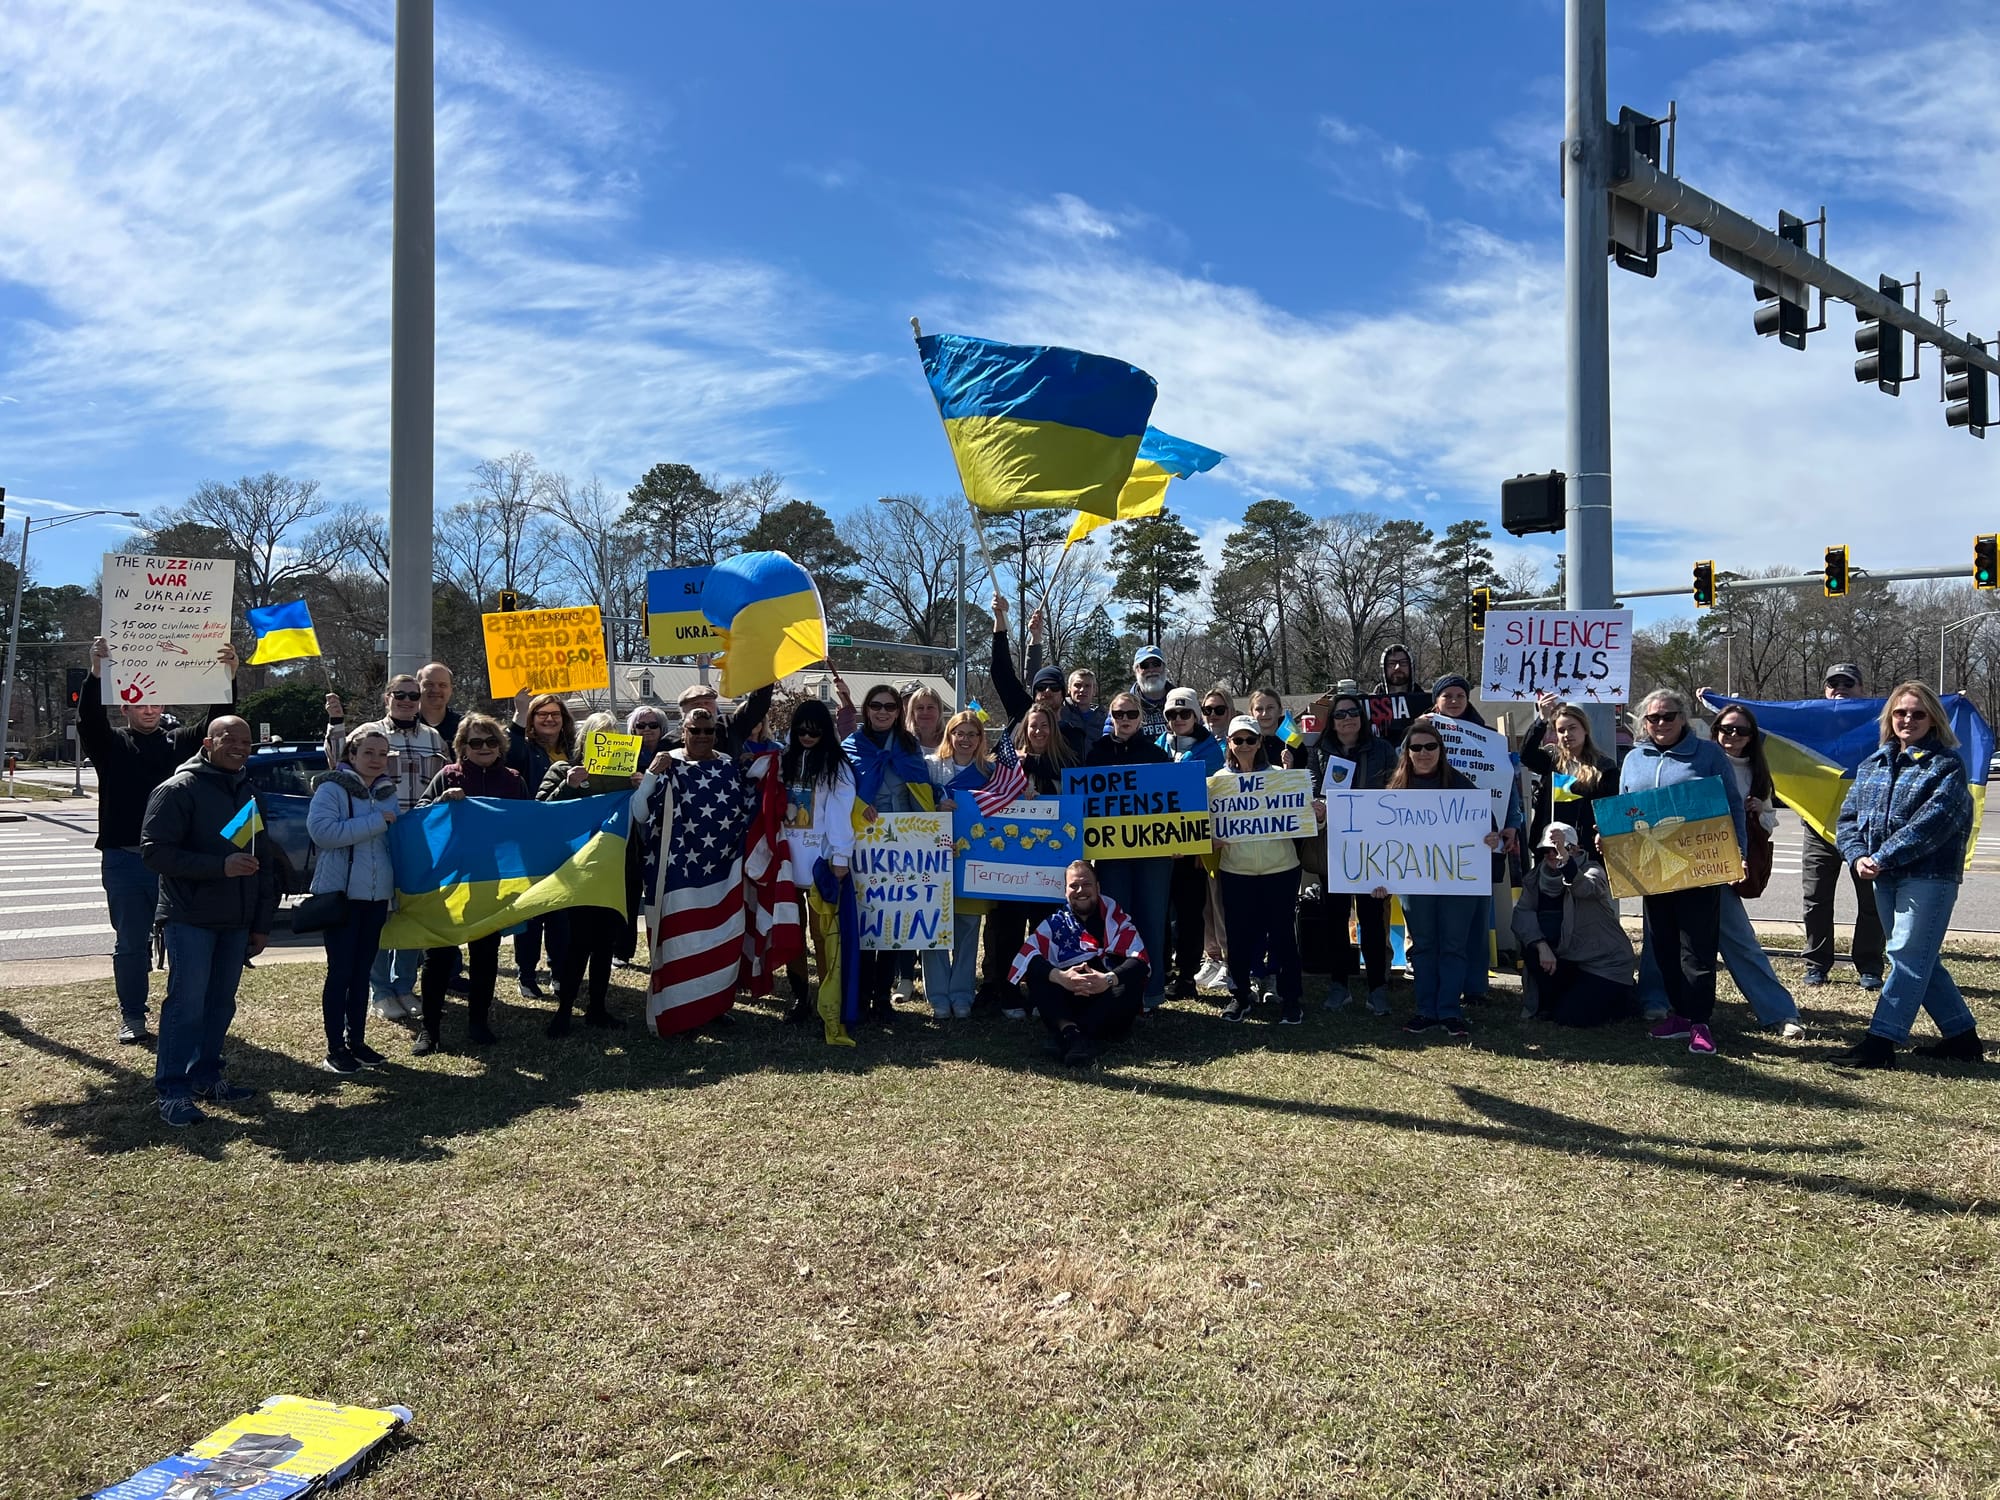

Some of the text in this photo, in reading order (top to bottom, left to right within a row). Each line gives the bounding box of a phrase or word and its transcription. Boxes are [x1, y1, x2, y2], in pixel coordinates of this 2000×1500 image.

[115, 556, 140, 568] THE
[147, 573, 187, 587] WAR
[134, 603, 165, 612] 2014
[179, 606, 212, 614] 2025
[121, 643, 154, 652] 6000
[121, 659, 148, 667] 1000
[1360, 695, 1410, 724] USSIA
[1143, 724, 1166, 736] PRED
[1440, 734, 1463, 745] ting.
[595, 745, 621, 758] Putin
[1460, 747, 1485, 758] ends.
[1448, 758, 1495, 772] aine stops
[1069, 770, 1137, 795] MORE
[1238, 775, 1265, 794] WE
[1490, 788, 1503, 799] tic
[1083, 791, 1181, 818] EFENSE
[1210, 792, 1305, 813] STAND WITH
[1337, 794, 1364, 833] I
[1215, 814, 1300, 839] UKRAINE
[1084, 825, 1116, 848] OR
[1678, 831, 1729, 847] WE STAND
[852, 848, 952, 875] UKRAINE
[1342, 840, 1477, 883] UKRAINE
[1693, 848, 1719, 860] WITH
[968, 864, 1029, 886] Terrorist
[865, 884, 939, 903] MUST
[860, 908, 940, 940] WIN
